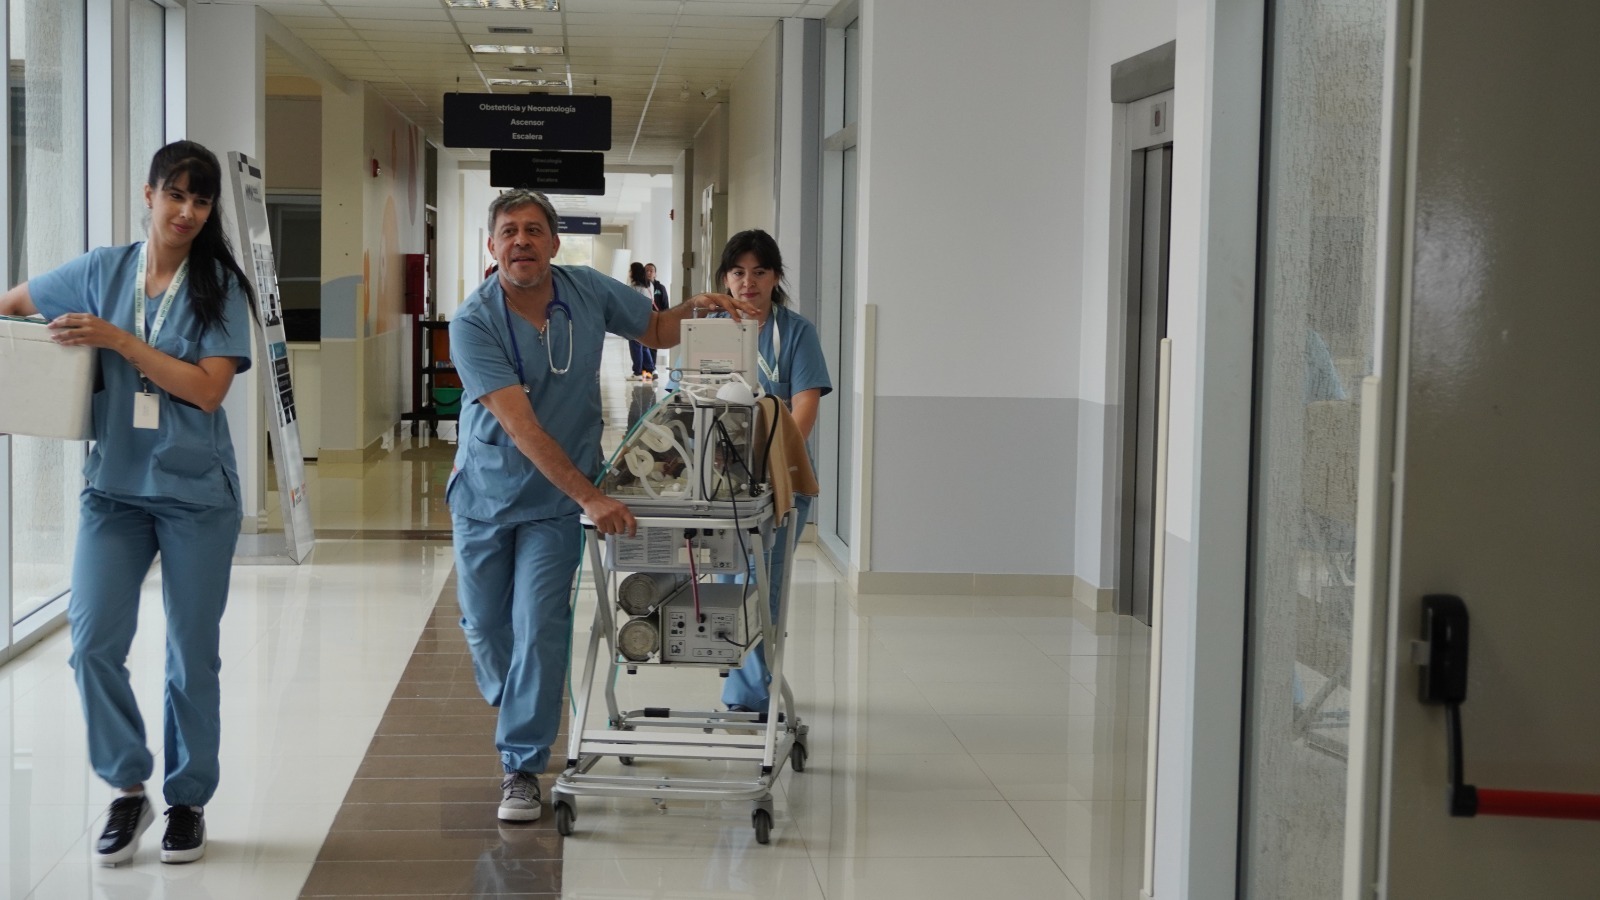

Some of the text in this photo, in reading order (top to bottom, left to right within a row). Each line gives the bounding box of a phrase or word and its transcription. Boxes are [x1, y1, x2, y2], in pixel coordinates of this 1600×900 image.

[479, 103, 576, 114] Obstetricia y Neonatología
[510, 118, 545, 126] Ascensor
[512, 132, 543, 140] Escalera
